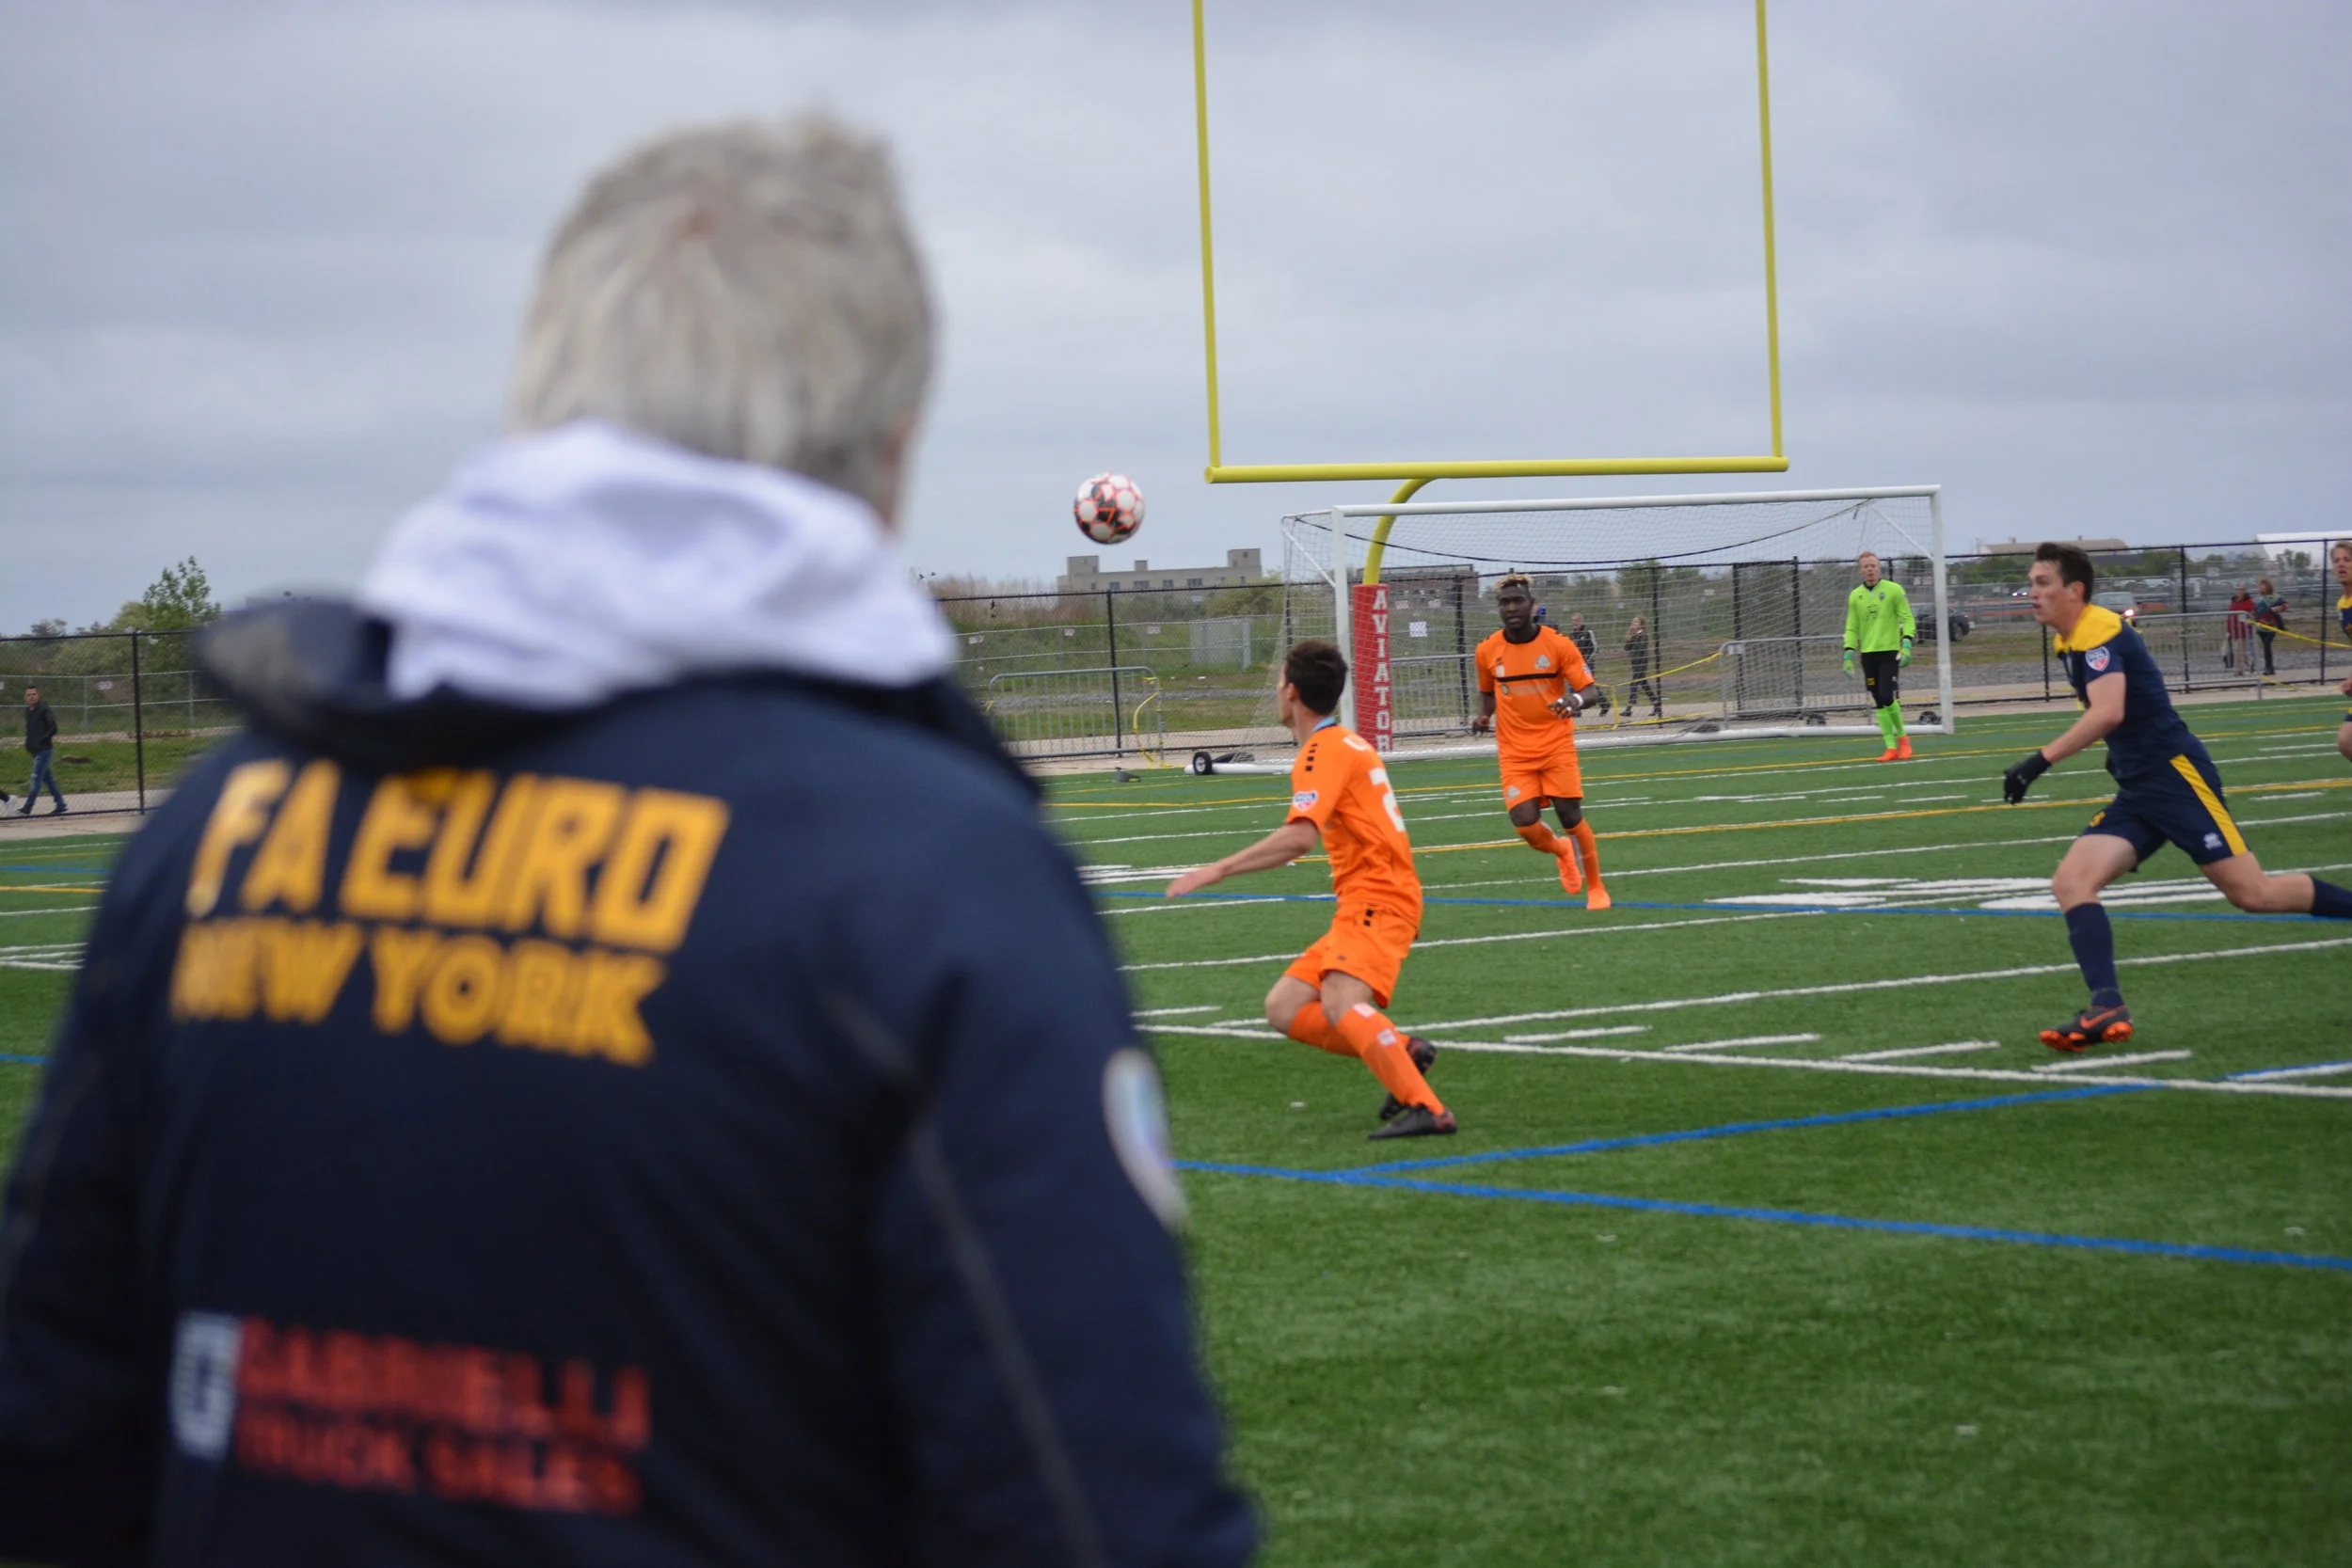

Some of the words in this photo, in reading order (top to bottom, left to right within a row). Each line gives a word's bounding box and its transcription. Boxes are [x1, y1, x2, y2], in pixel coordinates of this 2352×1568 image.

[186, 758, 342, 916] FA
[339, 767, 730, 953] EURO
[171, 918, 363, 1022] NEW
[370, 933, 668, 1067] YORK
